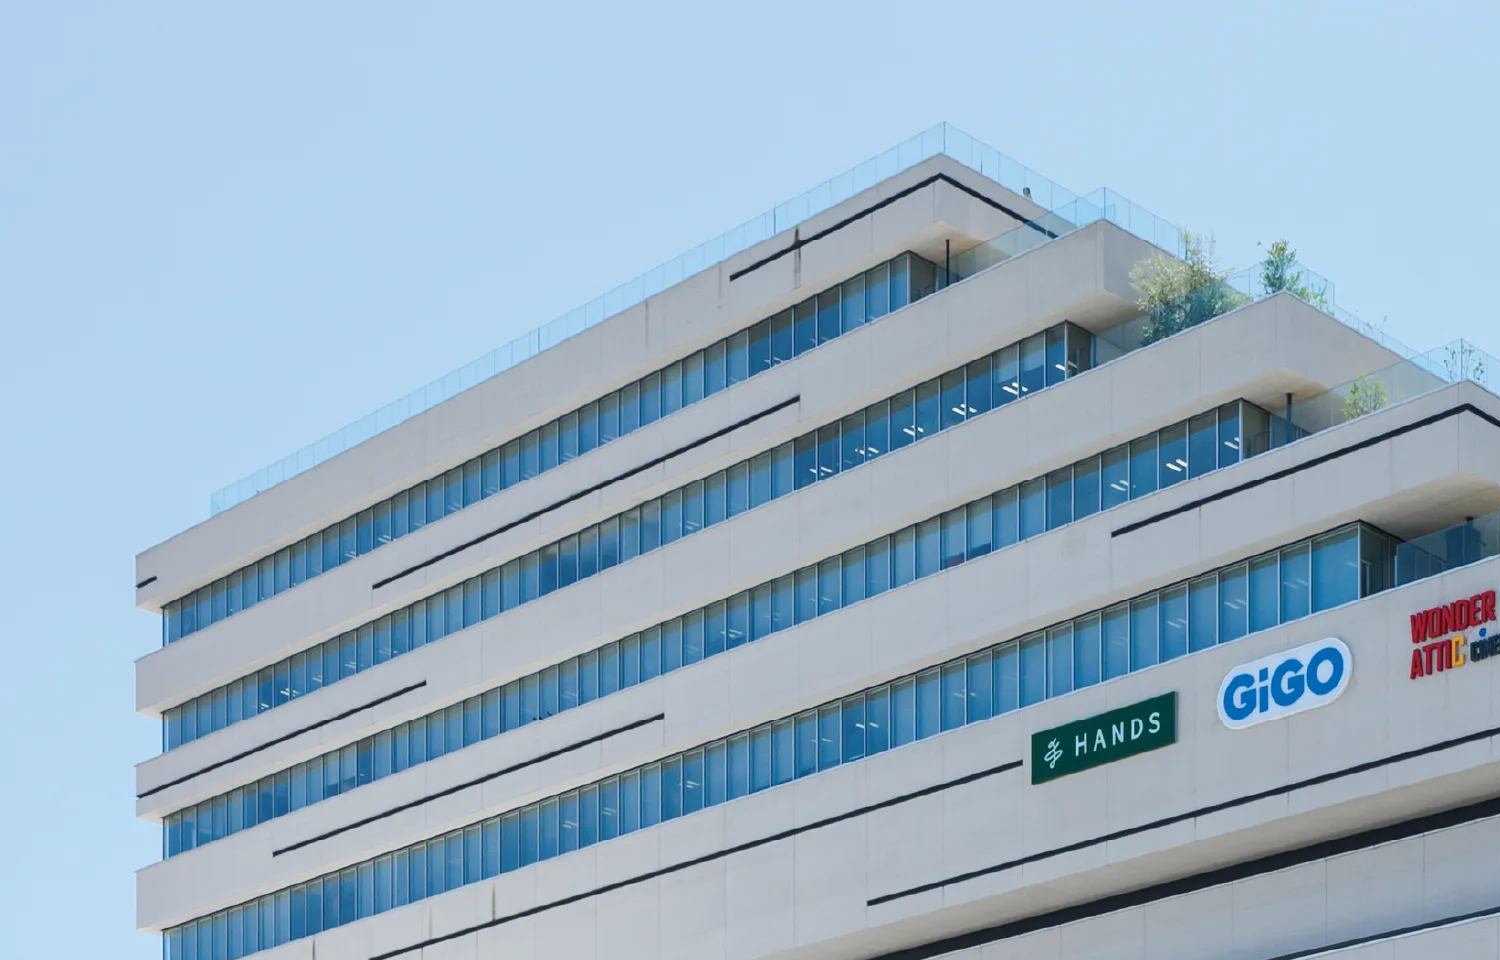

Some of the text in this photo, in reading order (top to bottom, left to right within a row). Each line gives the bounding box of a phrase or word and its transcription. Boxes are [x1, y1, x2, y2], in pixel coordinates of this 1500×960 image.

[1410, 590, 1497, 643] WONDER
[1410, 635, 1466, 680] ATTIC
[1074, 711, 1161, 757] HANDS
